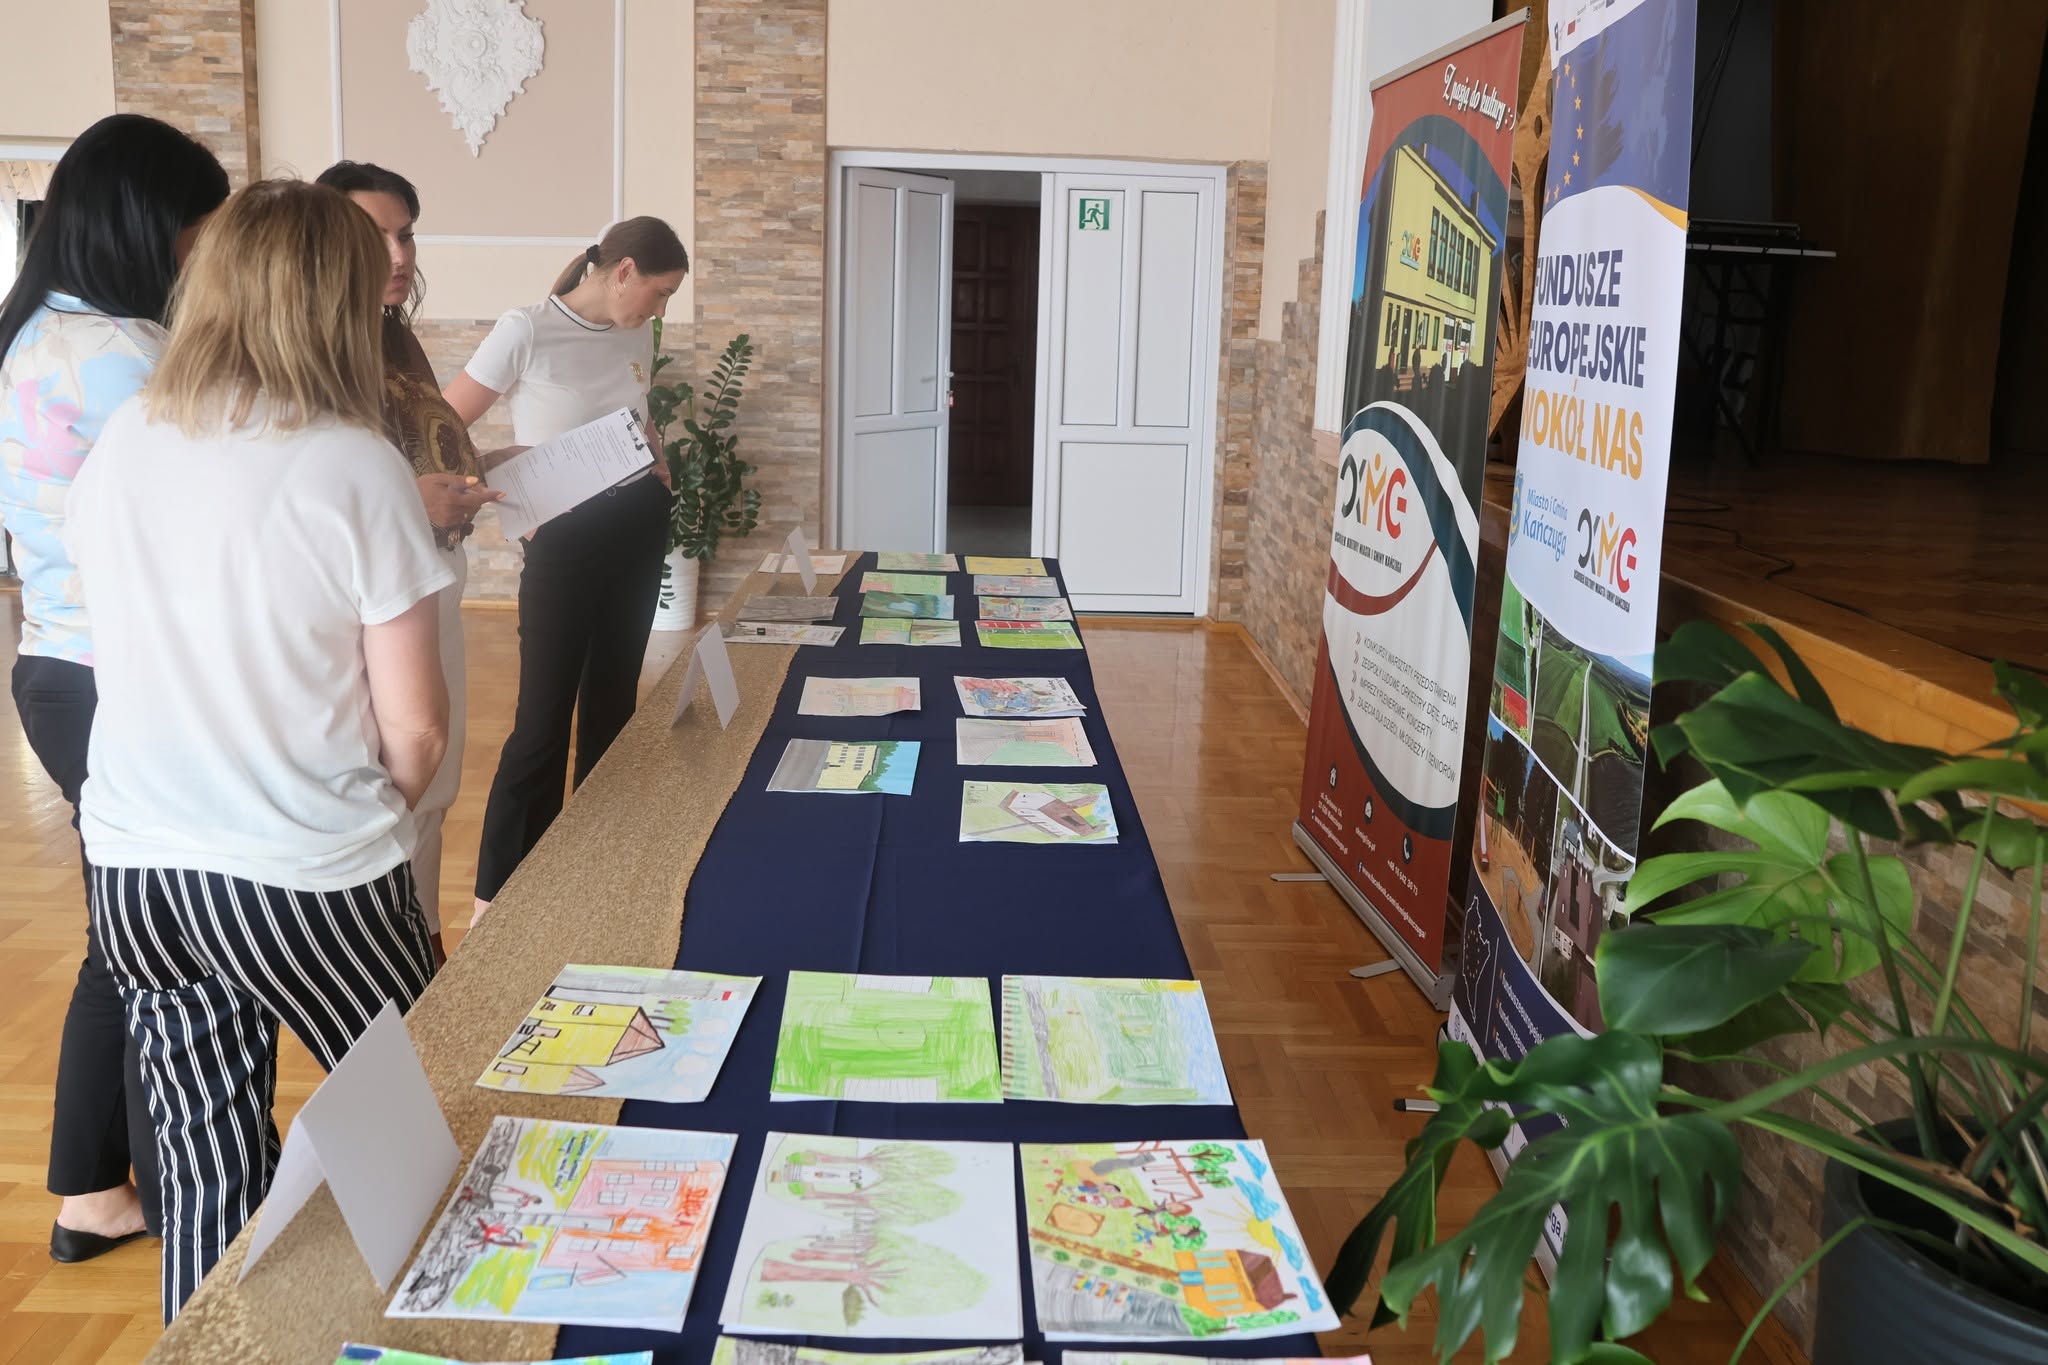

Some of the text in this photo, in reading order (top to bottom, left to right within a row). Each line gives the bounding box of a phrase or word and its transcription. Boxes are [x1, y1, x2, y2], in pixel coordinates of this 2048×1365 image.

[1449, 77, 1470, 111] pasją
[1469, 79, 1480, 110] do
[1480, 83, 1506, 130] kultury
[1528, 320, 1646, 388] EUROPEJSKIE
[1591, 402, 1643, 480] NAS
[1527, 488, 1549, 511] Miasto
[1553, 498, 1568, 521] Gmina
[1523, 510, 1567, 562] Kańczuga
